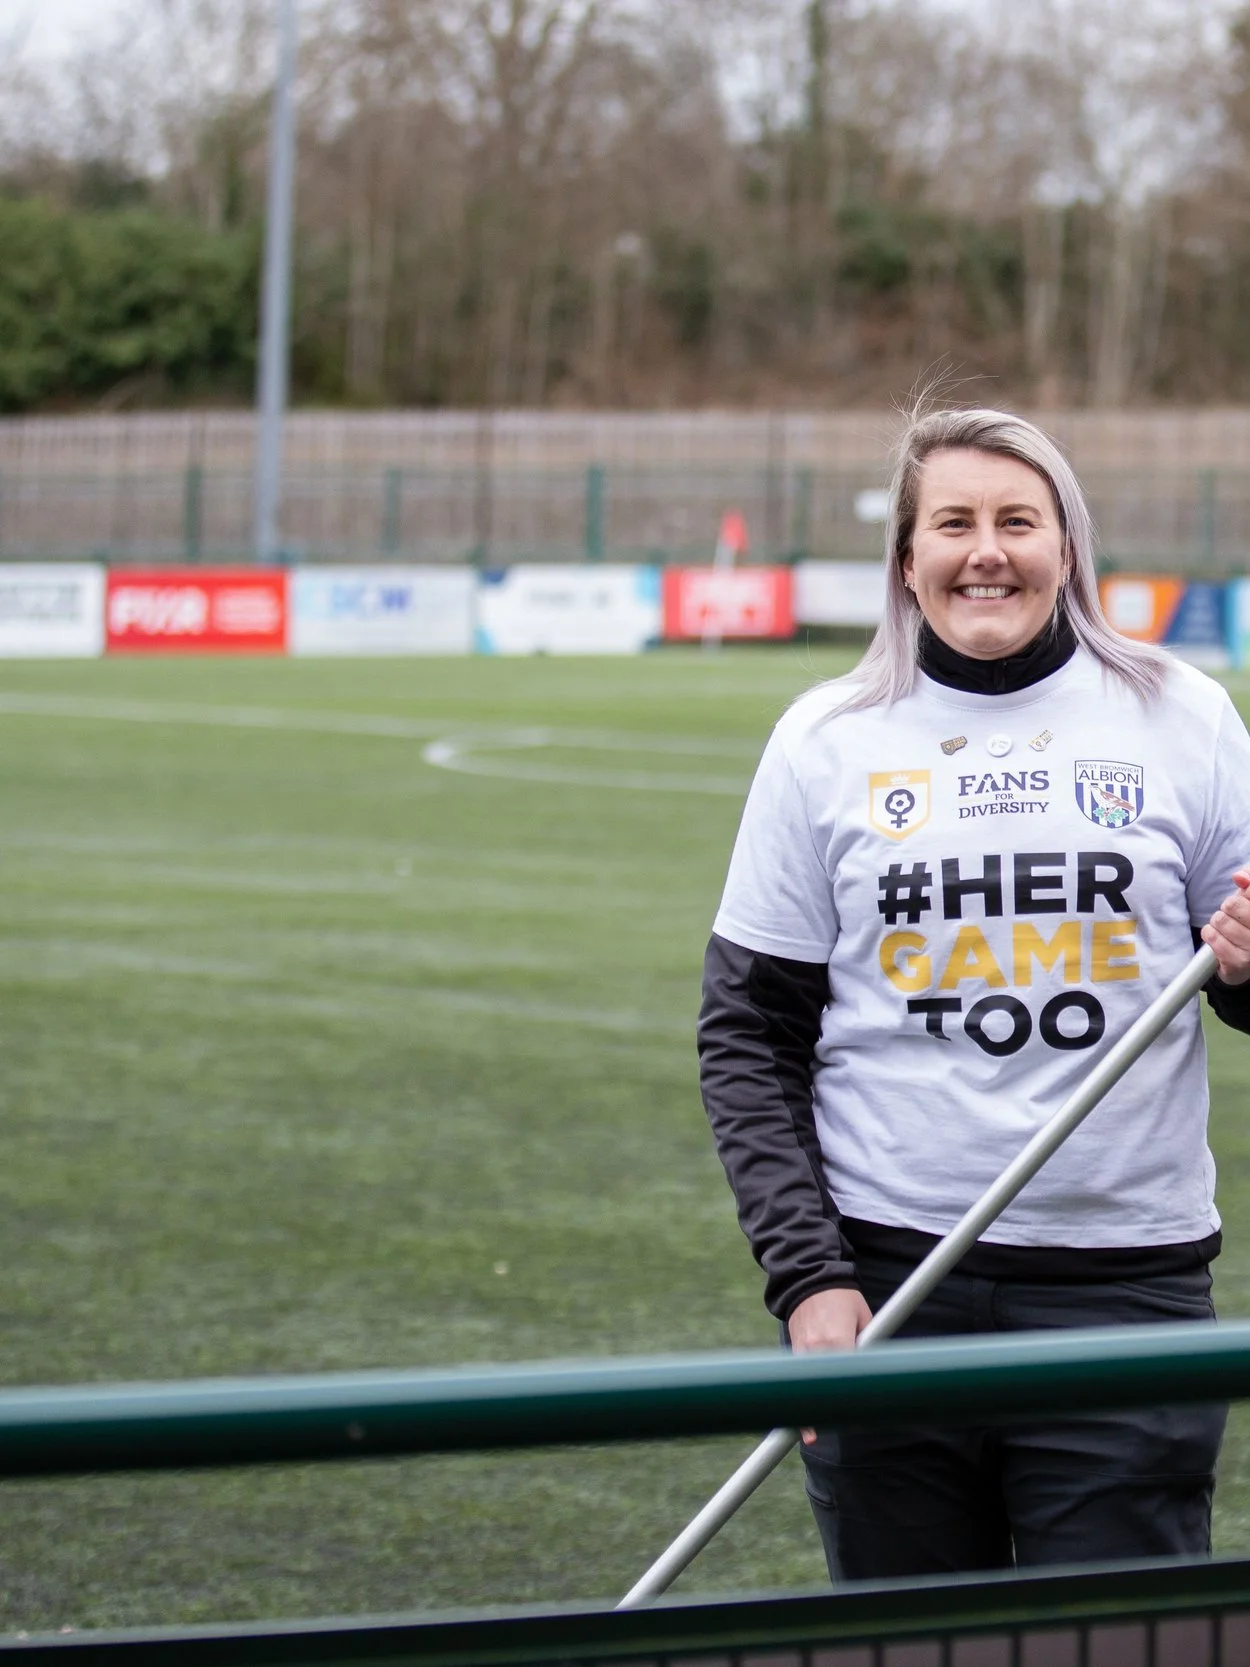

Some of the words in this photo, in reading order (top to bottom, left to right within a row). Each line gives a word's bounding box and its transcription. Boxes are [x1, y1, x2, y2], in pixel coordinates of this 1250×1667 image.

[957, 770, 1050, 797] FANS
[1078, 769, 1139, 785] ALBION
[958, 801, 1050, 820] DIVERSITY
[994, 793, 1014, 801] FOR
[877, 851, 1135, 926] #HER
[878, 919, 1141, 993] GAME
[906, 990, 1106, 1058] TOO
